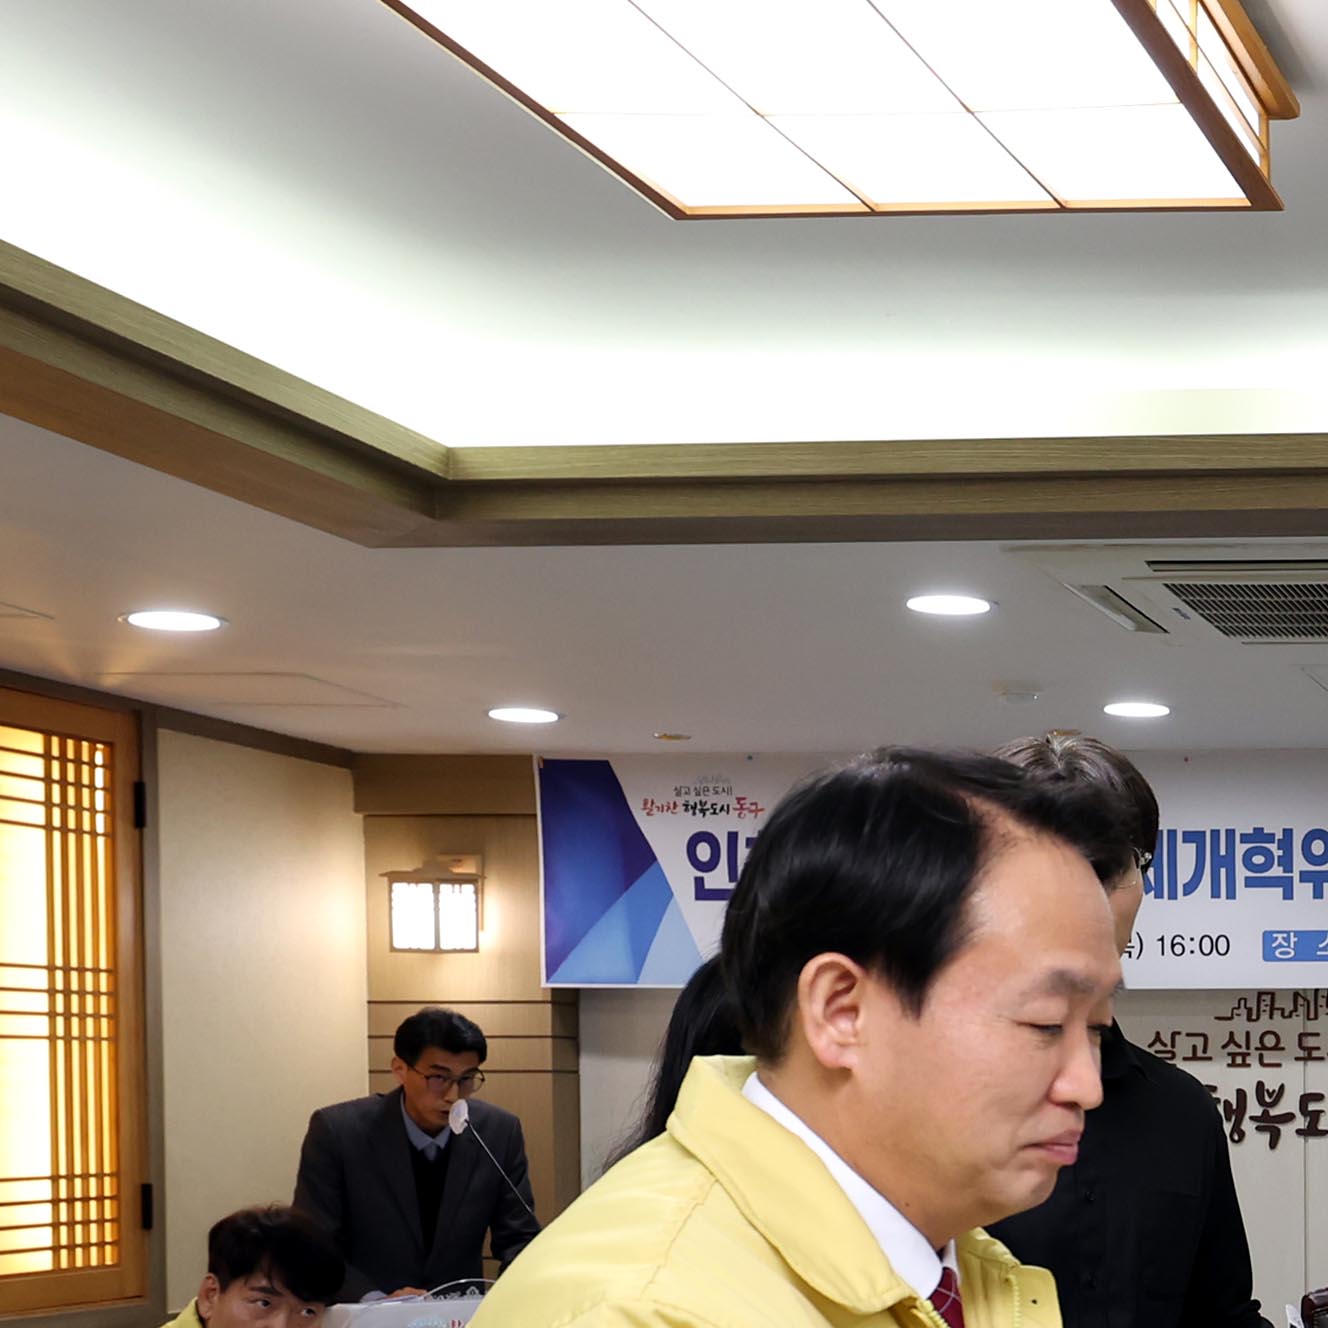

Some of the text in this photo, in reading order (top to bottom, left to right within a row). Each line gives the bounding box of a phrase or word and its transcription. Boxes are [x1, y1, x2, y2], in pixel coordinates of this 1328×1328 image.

[682, 799, 730, 818] 행복도시
[732, 797, 766, 819] 동구
[686, 831, 760, 901] 인
[1157, 934, 1231, 957] 16:00
[1221, 1030, 1285, 1068] 싶은
